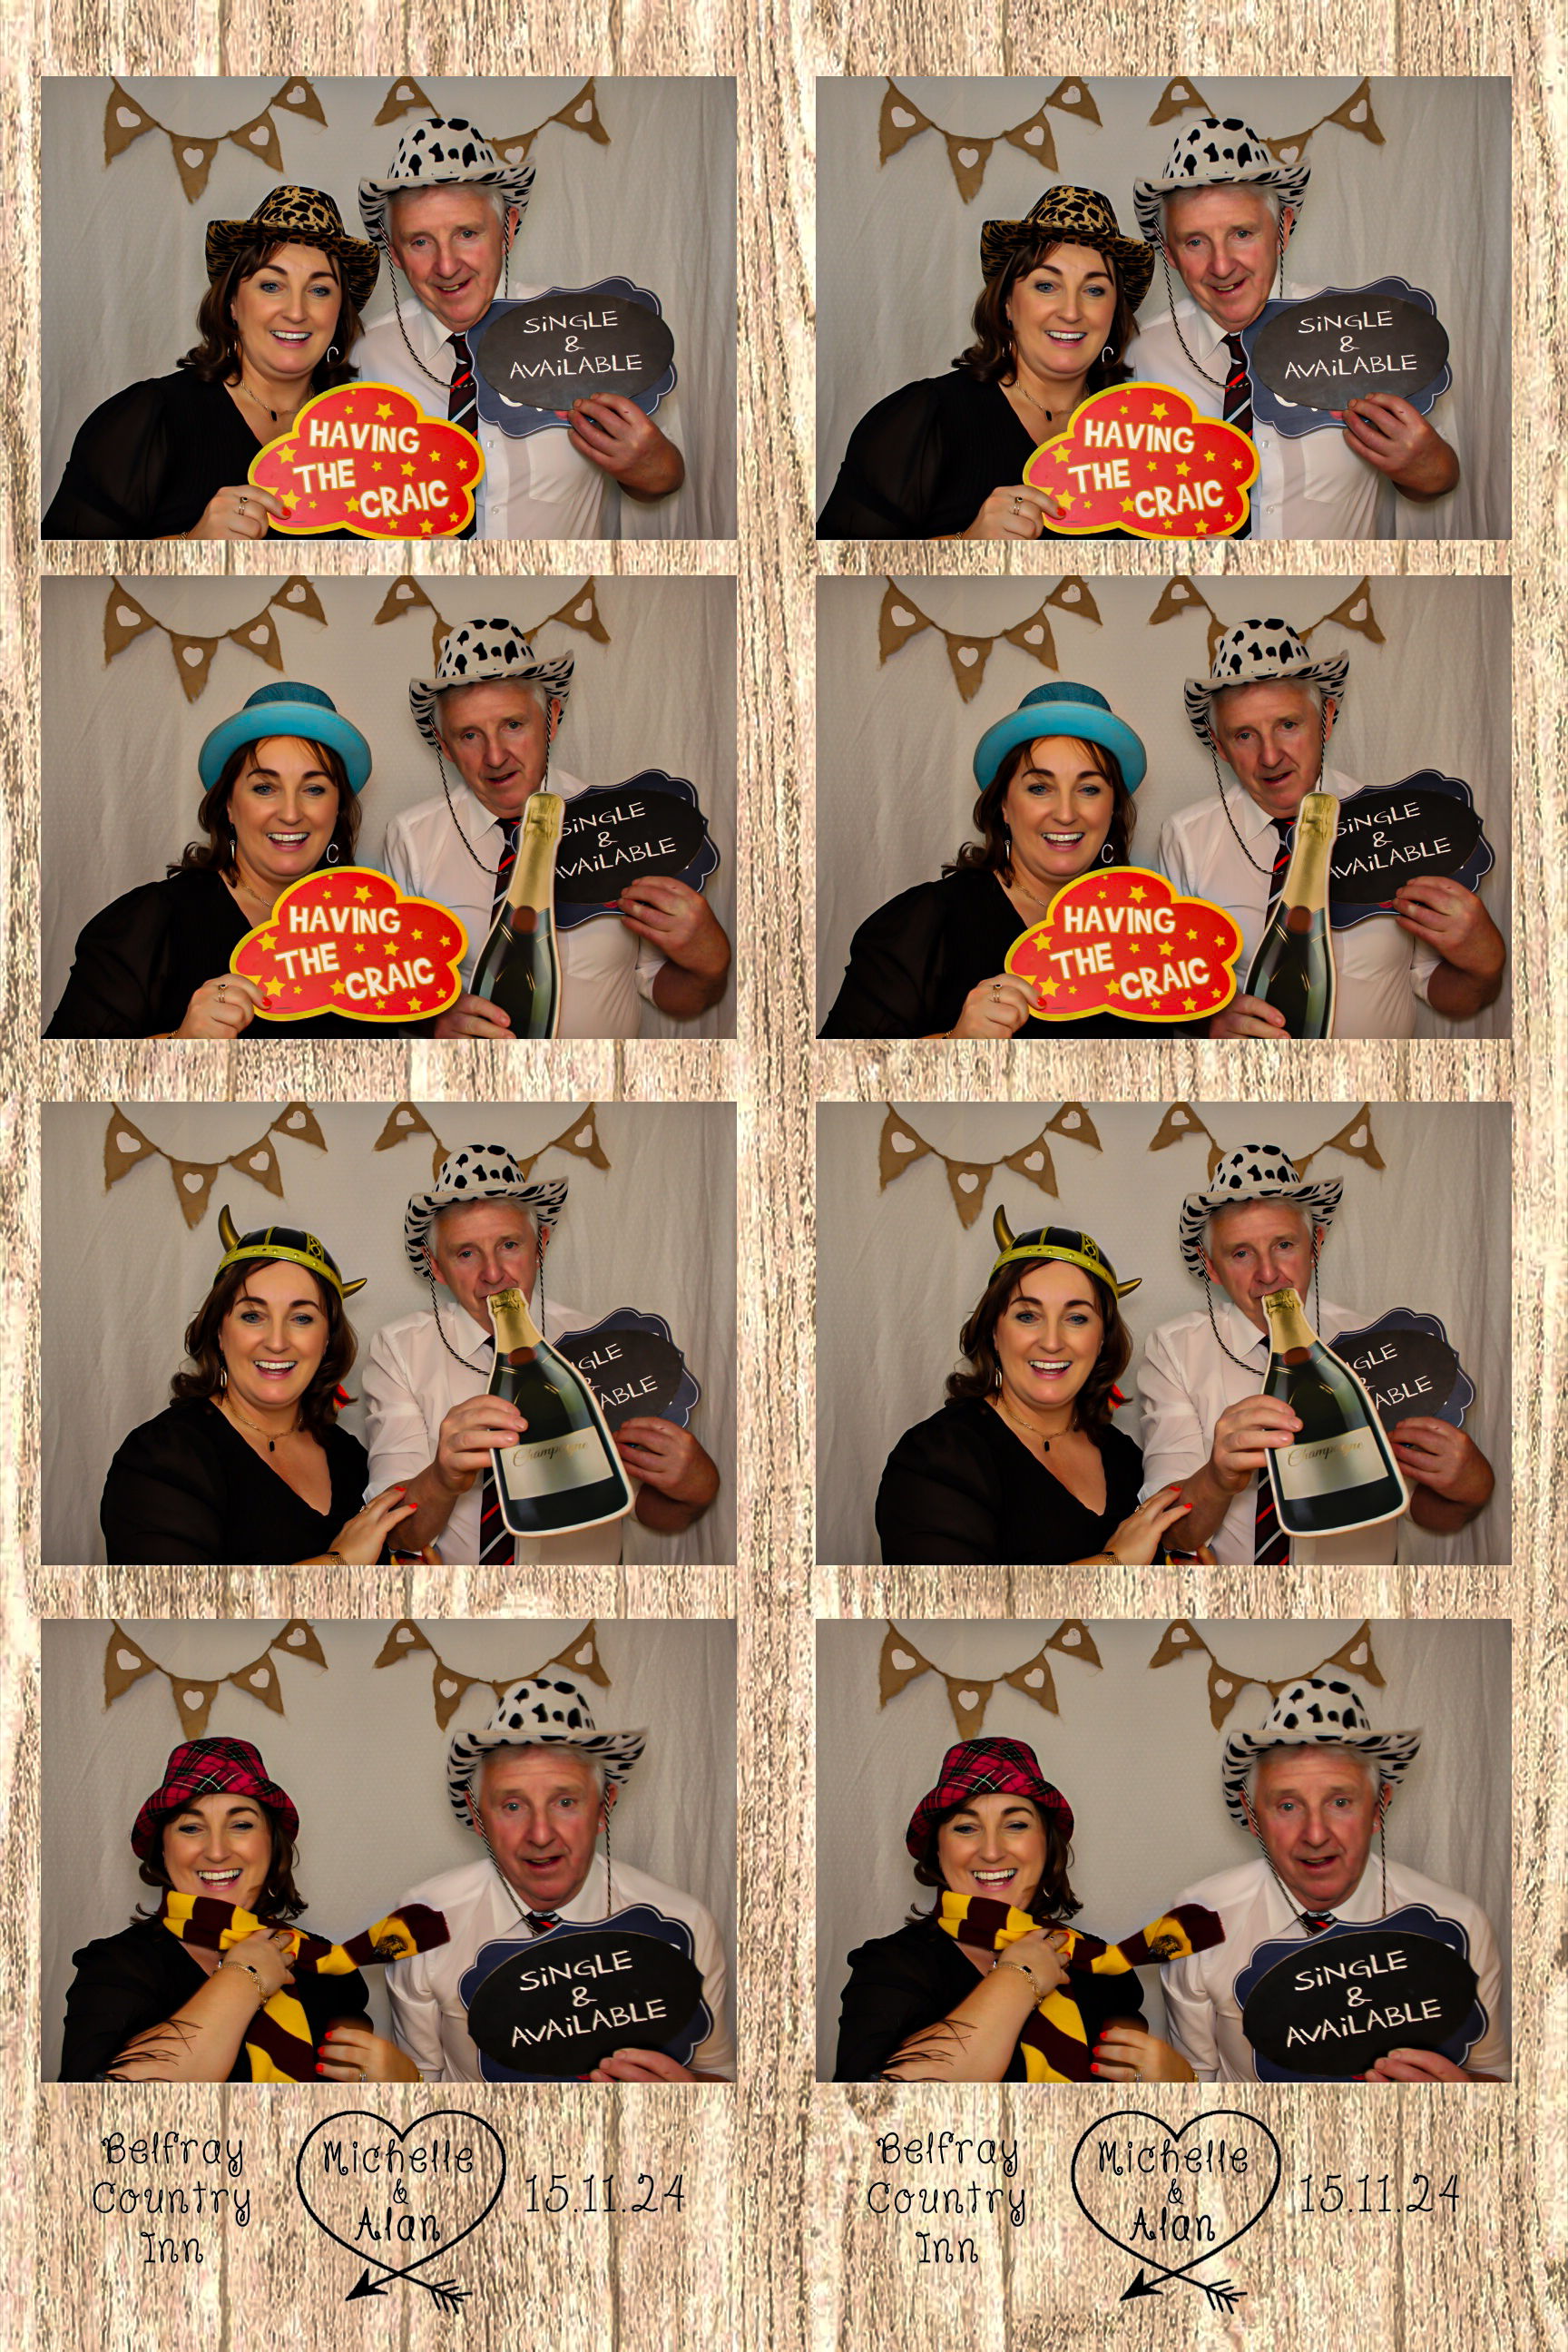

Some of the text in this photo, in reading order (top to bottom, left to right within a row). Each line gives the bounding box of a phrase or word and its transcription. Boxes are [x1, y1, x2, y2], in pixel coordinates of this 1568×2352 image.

[523, 310, 619, 334] SiNGLE
[1298, 310, 1394, 334] SiNGLE
[564, 335, 585, 353] &
[1339, 335, 1360, 353] &
[509, 354, 642, 379] AVAiLABLE
[1284, 354, 1417, 379] AVAiLABLE
[309, 419, 420, 454] HAVING
[1084, 419, 1195, 454] HAVING
[293, 458, 356, 494] THE
[1068, 458, 1131, 494] THE
[360, 480, 450, 518] CRAIC
[1135, 480, 1225, 518] CRAIC
[597, 831, 619, 848] &
[1372, 831, 1394, 848] &
[289, 906, 401, 935] HAVING
[1063, 906, 1176, 935] HAVING
[275, 943, 340, 979] THE
[345, 957, 436, 1000] CRAIC
[1050, 943, 1115, 979] THE
[1120, 957, 1210, 1000] CRAIC
[519, 1950, 633, 1991] SiNGLE
[1294, 1950, 1408, 1991] SiNGLE
[572, 1986, 598, 2007] &
[1347, 1986, 1373, 2007] &
[511, 1998, 668, 2048] AVAiLABLE
[1286, 1998, 1443, 2048] AVAiLABLE
